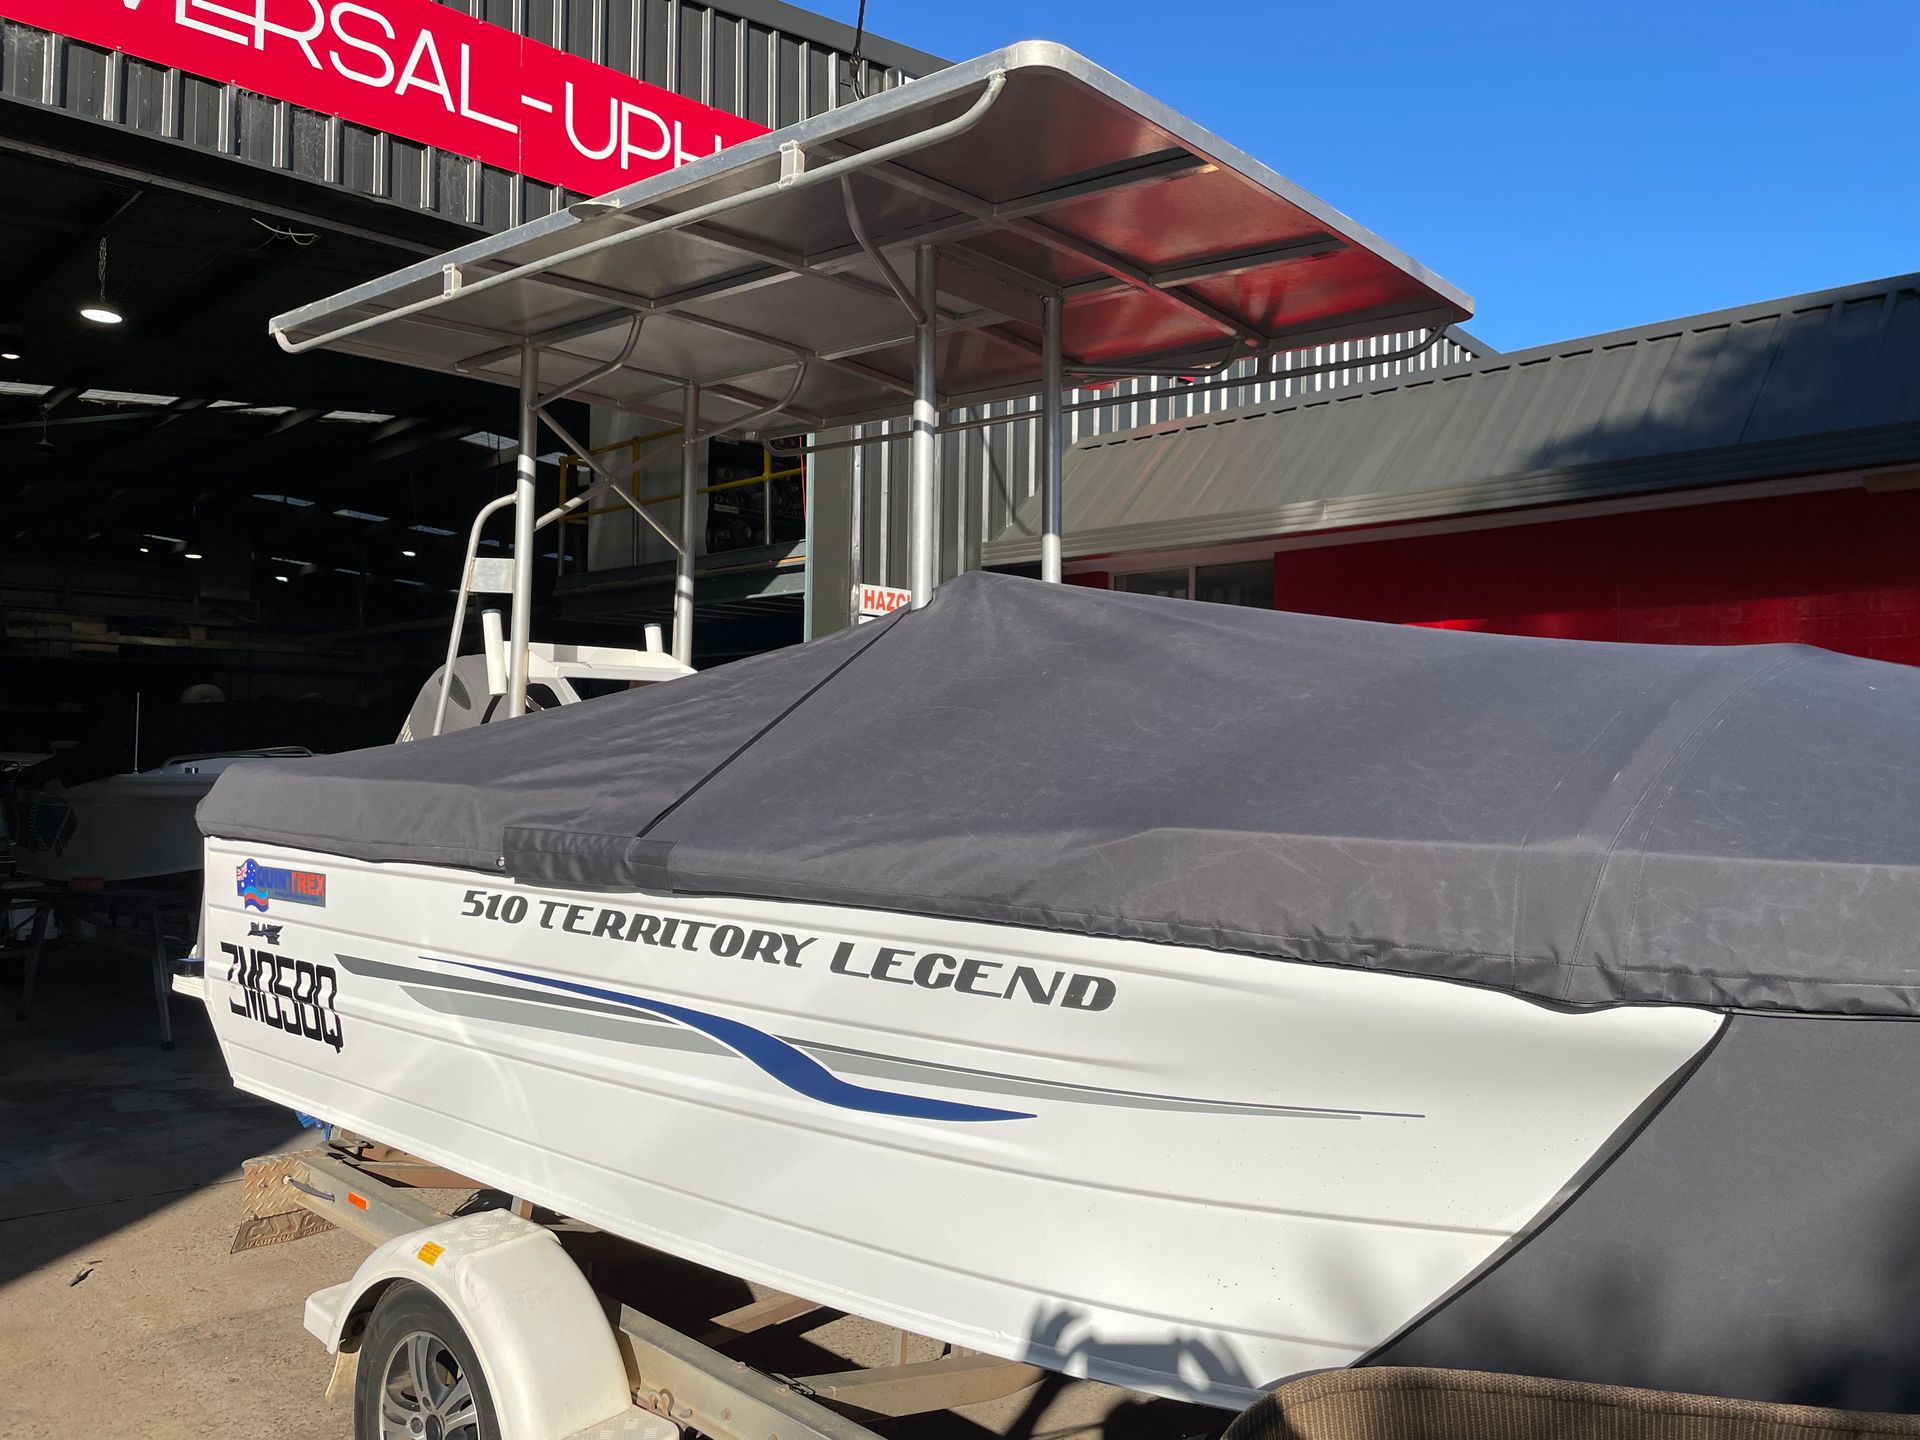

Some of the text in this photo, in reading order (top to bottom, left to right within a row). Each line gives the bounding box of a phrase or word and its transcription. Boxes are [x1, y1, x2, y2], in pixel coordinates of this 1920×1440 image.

[863, 589, 911, 611] HAZC
[461, 889, 1117, 1012] 510 TERRITORY LEGEND
